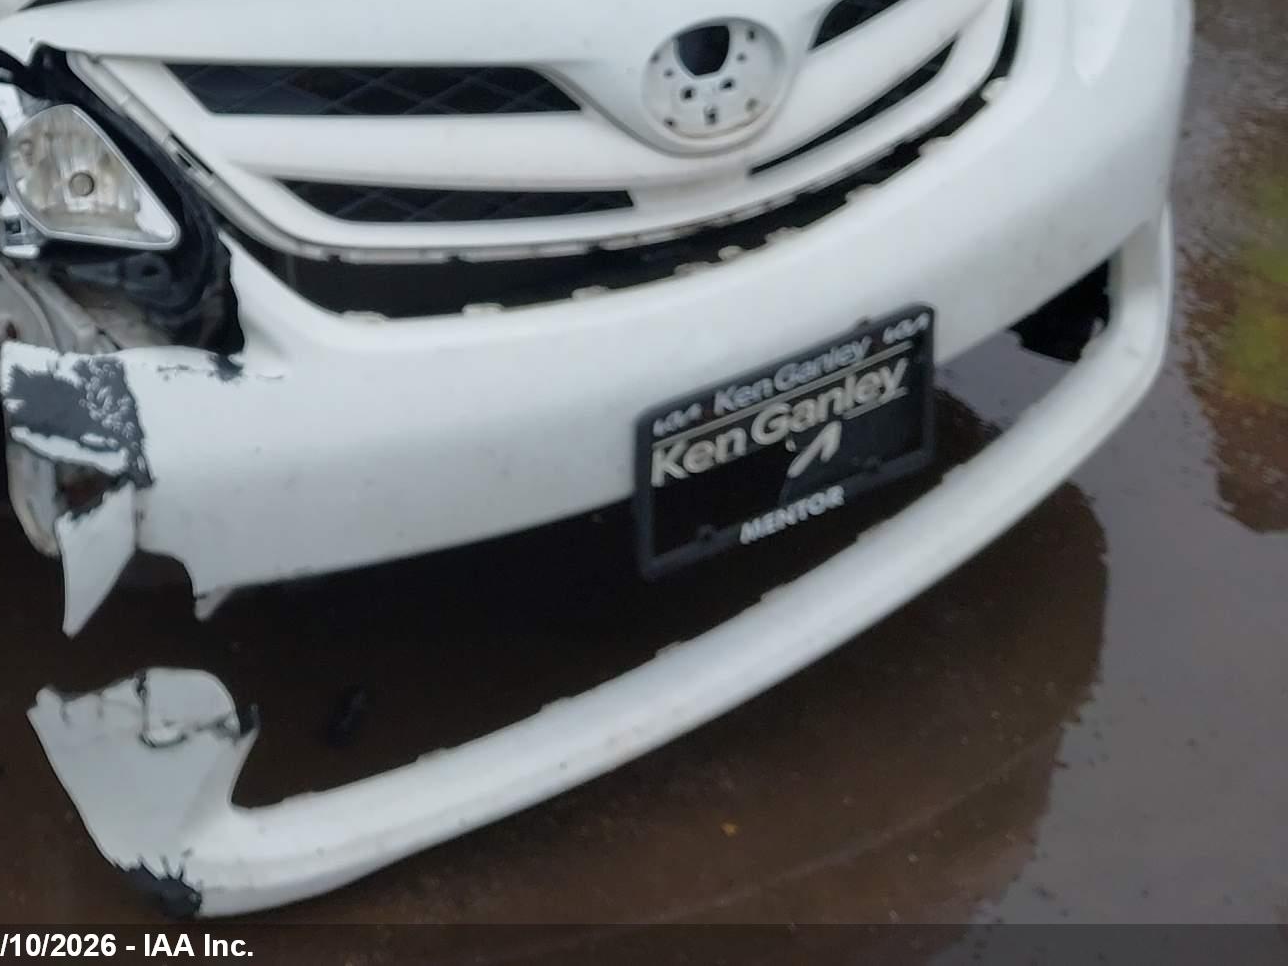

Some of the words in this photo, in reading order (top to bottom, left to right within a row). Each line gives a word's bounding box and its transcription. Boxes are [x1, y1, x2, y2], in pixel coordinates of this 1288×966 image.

[714, 378, 773, 415] Ken
[774, 336, 871, 391] Ganley
[651, 428, 746, 487] Ken
[751, 357, 909, 445] Ganley
[740, 485, 845, 545] MENTOR
